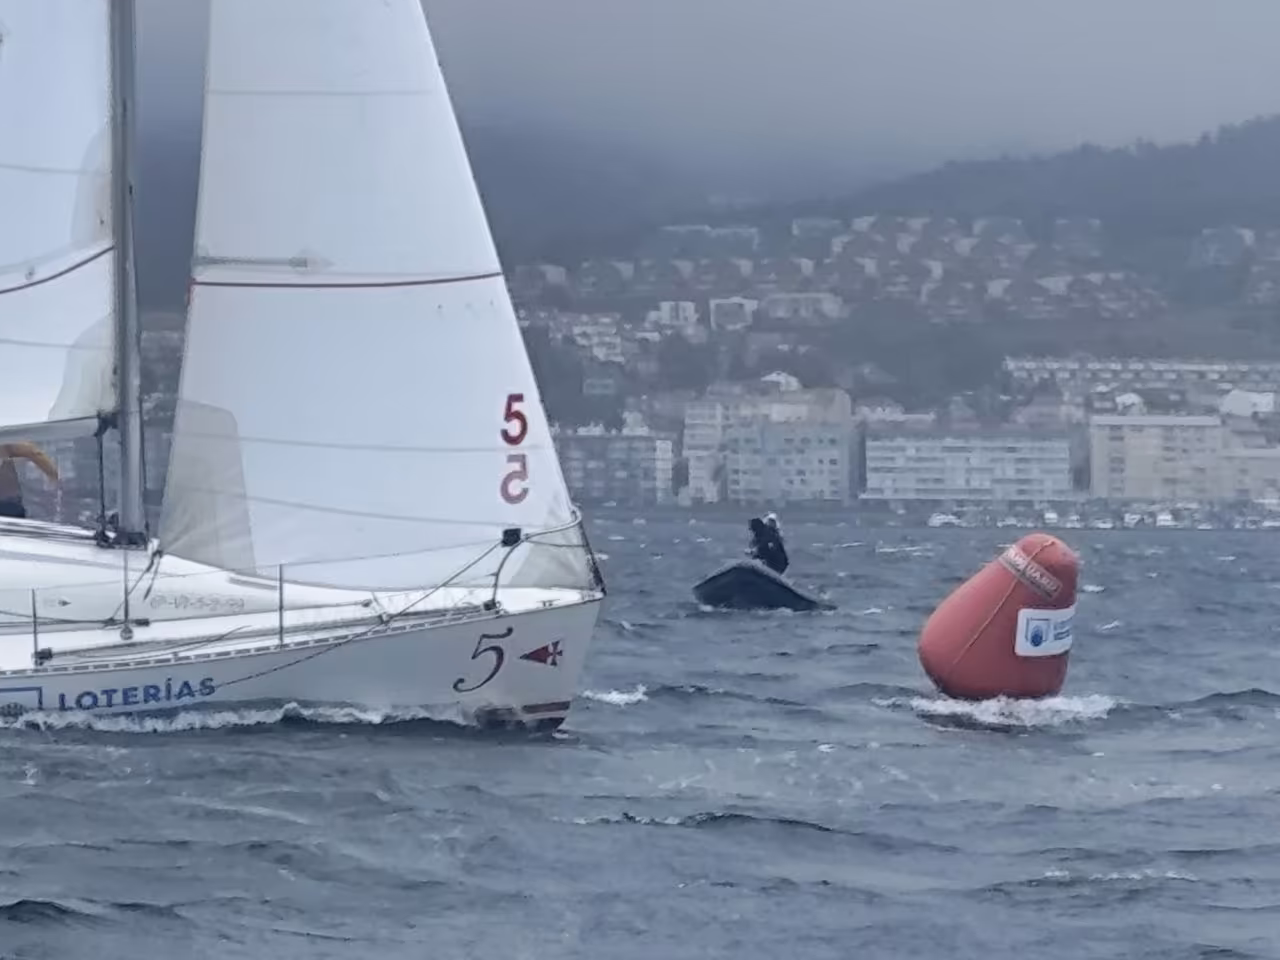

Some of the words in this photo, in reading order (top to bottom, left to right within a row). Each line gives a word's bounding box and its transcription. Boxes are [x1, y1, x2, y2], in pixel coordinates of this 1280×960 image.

[500, 393, 528, 446] 5
[453, 626, 513, 693] 5
[58, 677, 216, 711] LOTERÍAS
